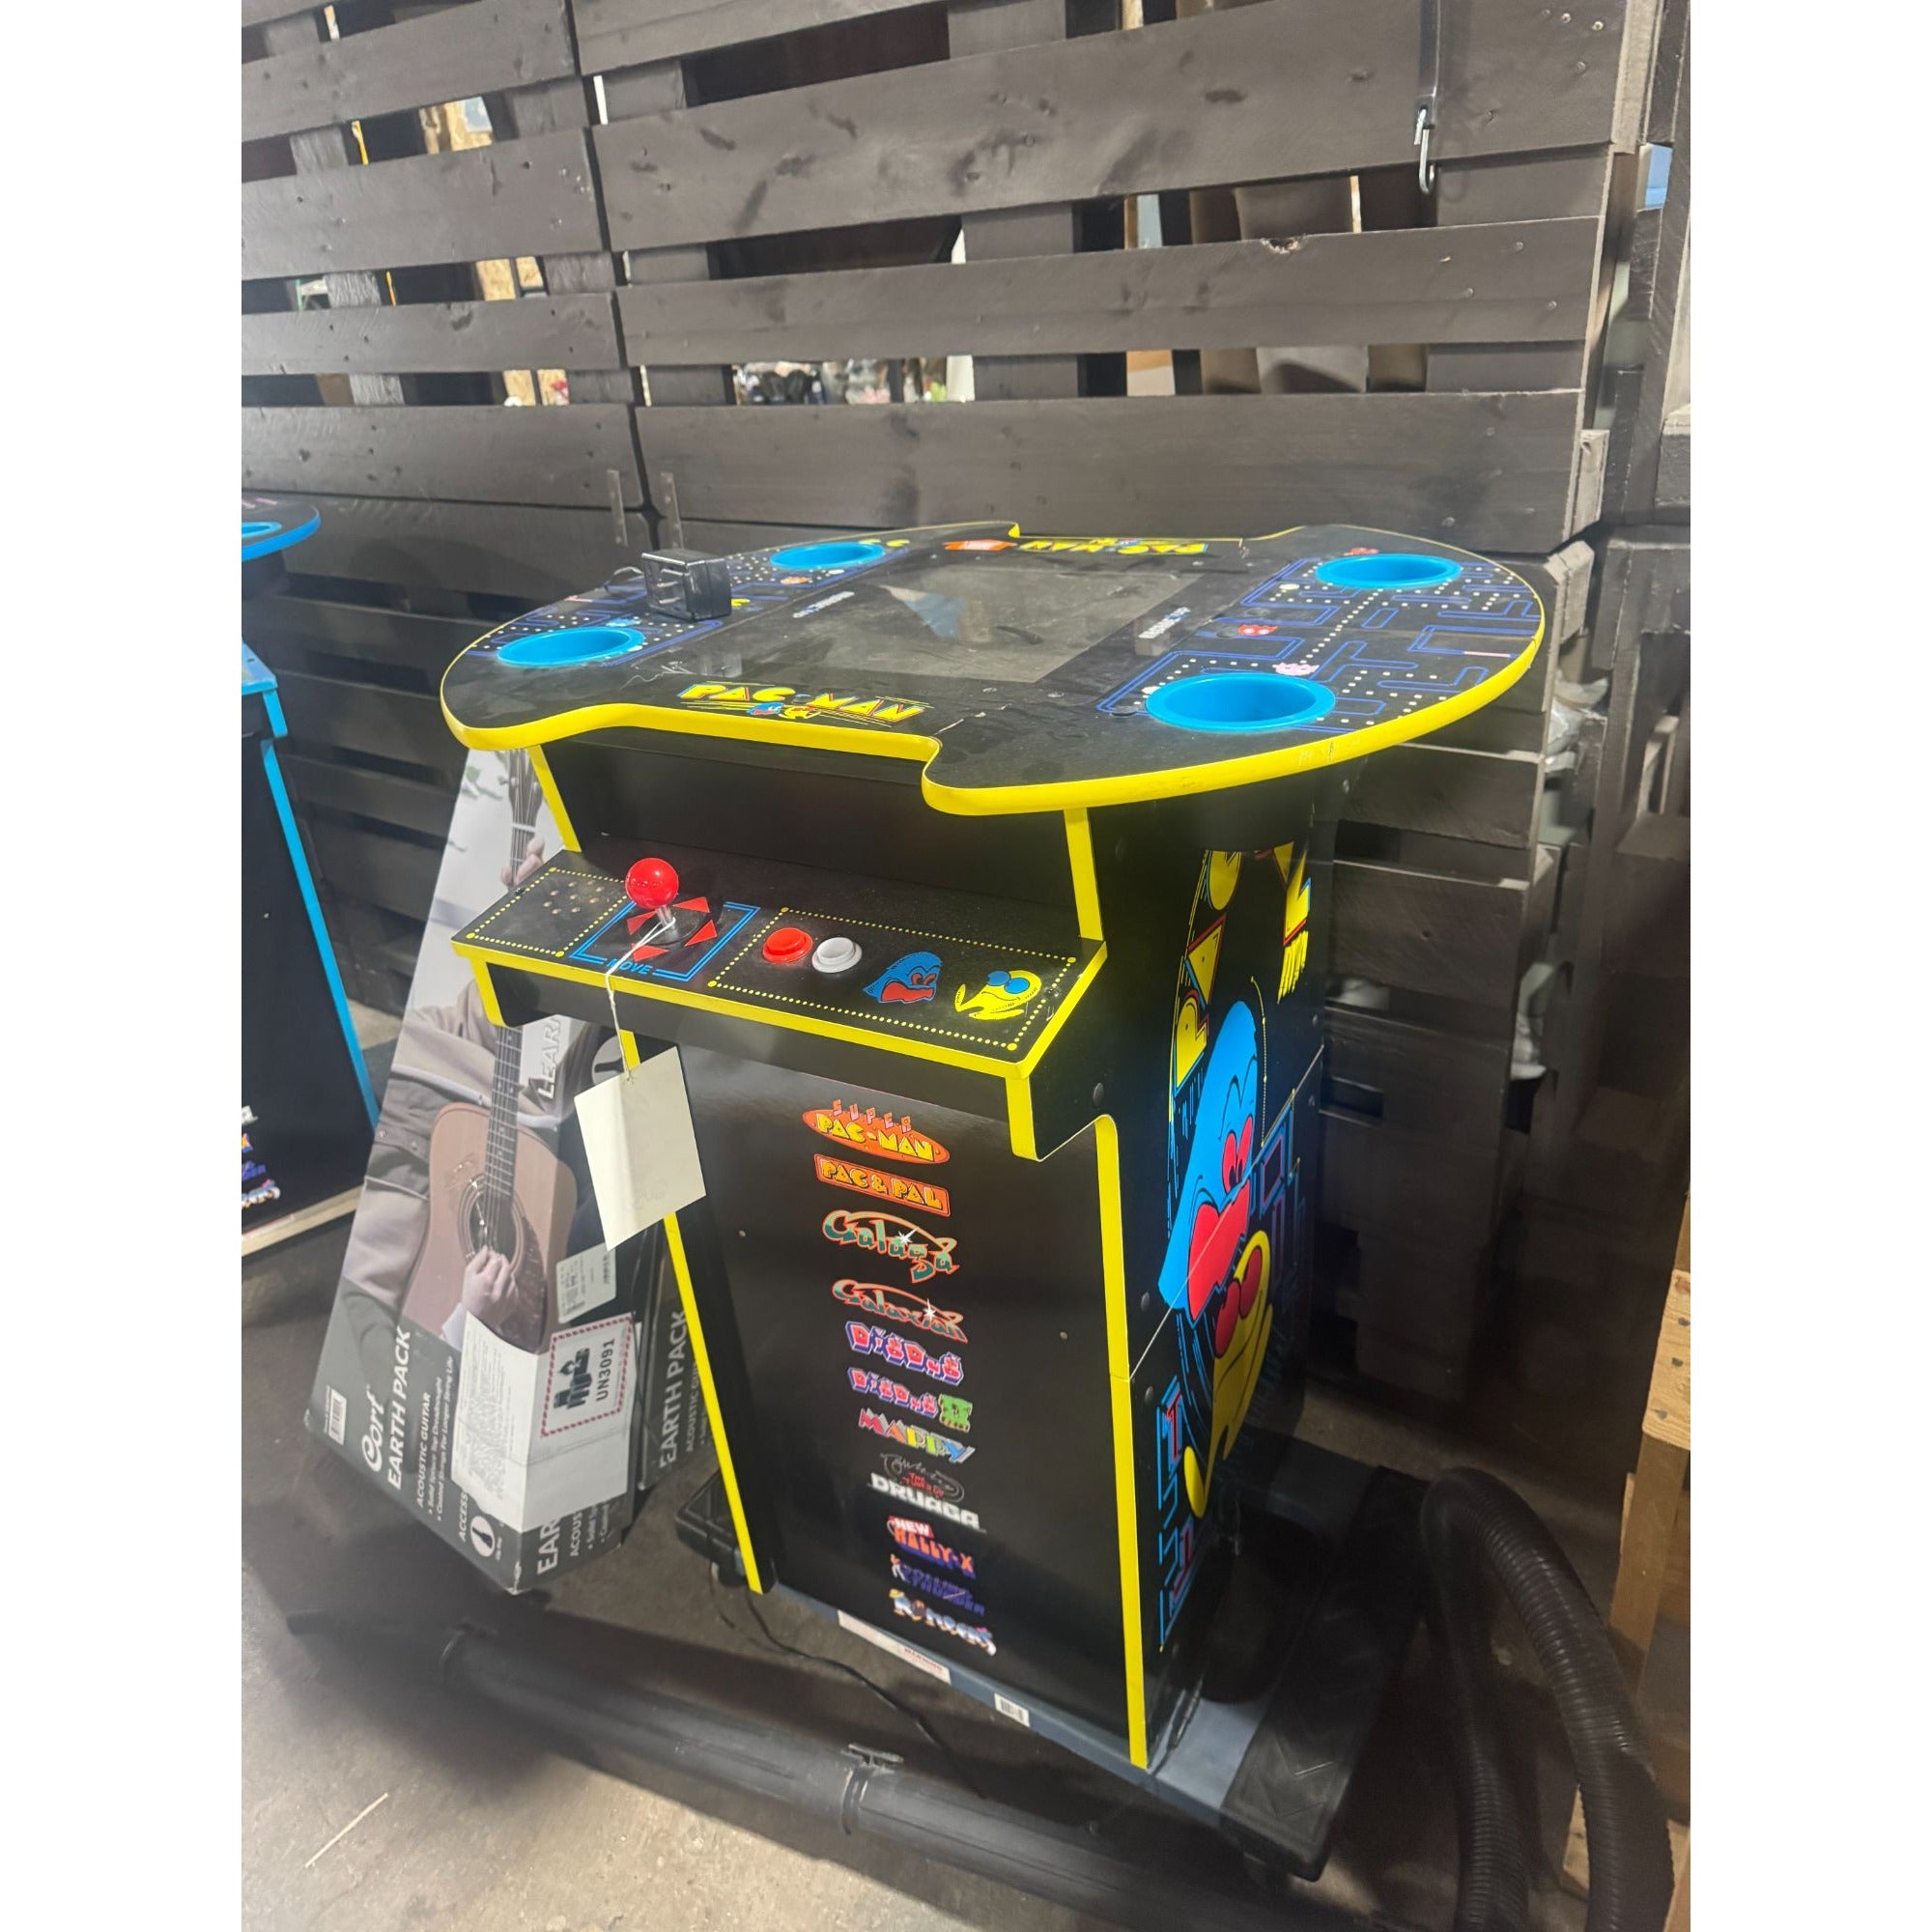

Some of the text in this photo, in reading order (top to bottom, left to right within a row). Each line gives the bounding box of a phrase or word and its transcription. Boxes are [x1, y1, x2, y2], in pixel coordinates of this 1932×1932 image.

[677, 684, 925, 723] PAC-MAN
[816, 1113, 934, 1161] PAC-MAN
[833, 1099, 911, 1133] SUPER
[821, 1158, 943, 1209] PAC & PAL
[823, 1209, 960, 1284] Galaga
[832, 1279, 968, 1344] Galaxian
[596, 1338, 614, 1402] UN3091
[659, 1311, 687, 1468] EARTH PACK
[361, 1389, 385, 1472] Cort
[388, 1324, 411, 1490] EARTH PACK
[858, 1407, 976, 1463] MAPPY
[416, 1391, 431, 1508] ACOUSTIC GUITAR
[871, 1472, 980, 1530] DRUAGA
[894, 1517, 930, 1537] NEW
[894, 1528, 975, 1578] RALLY-X
